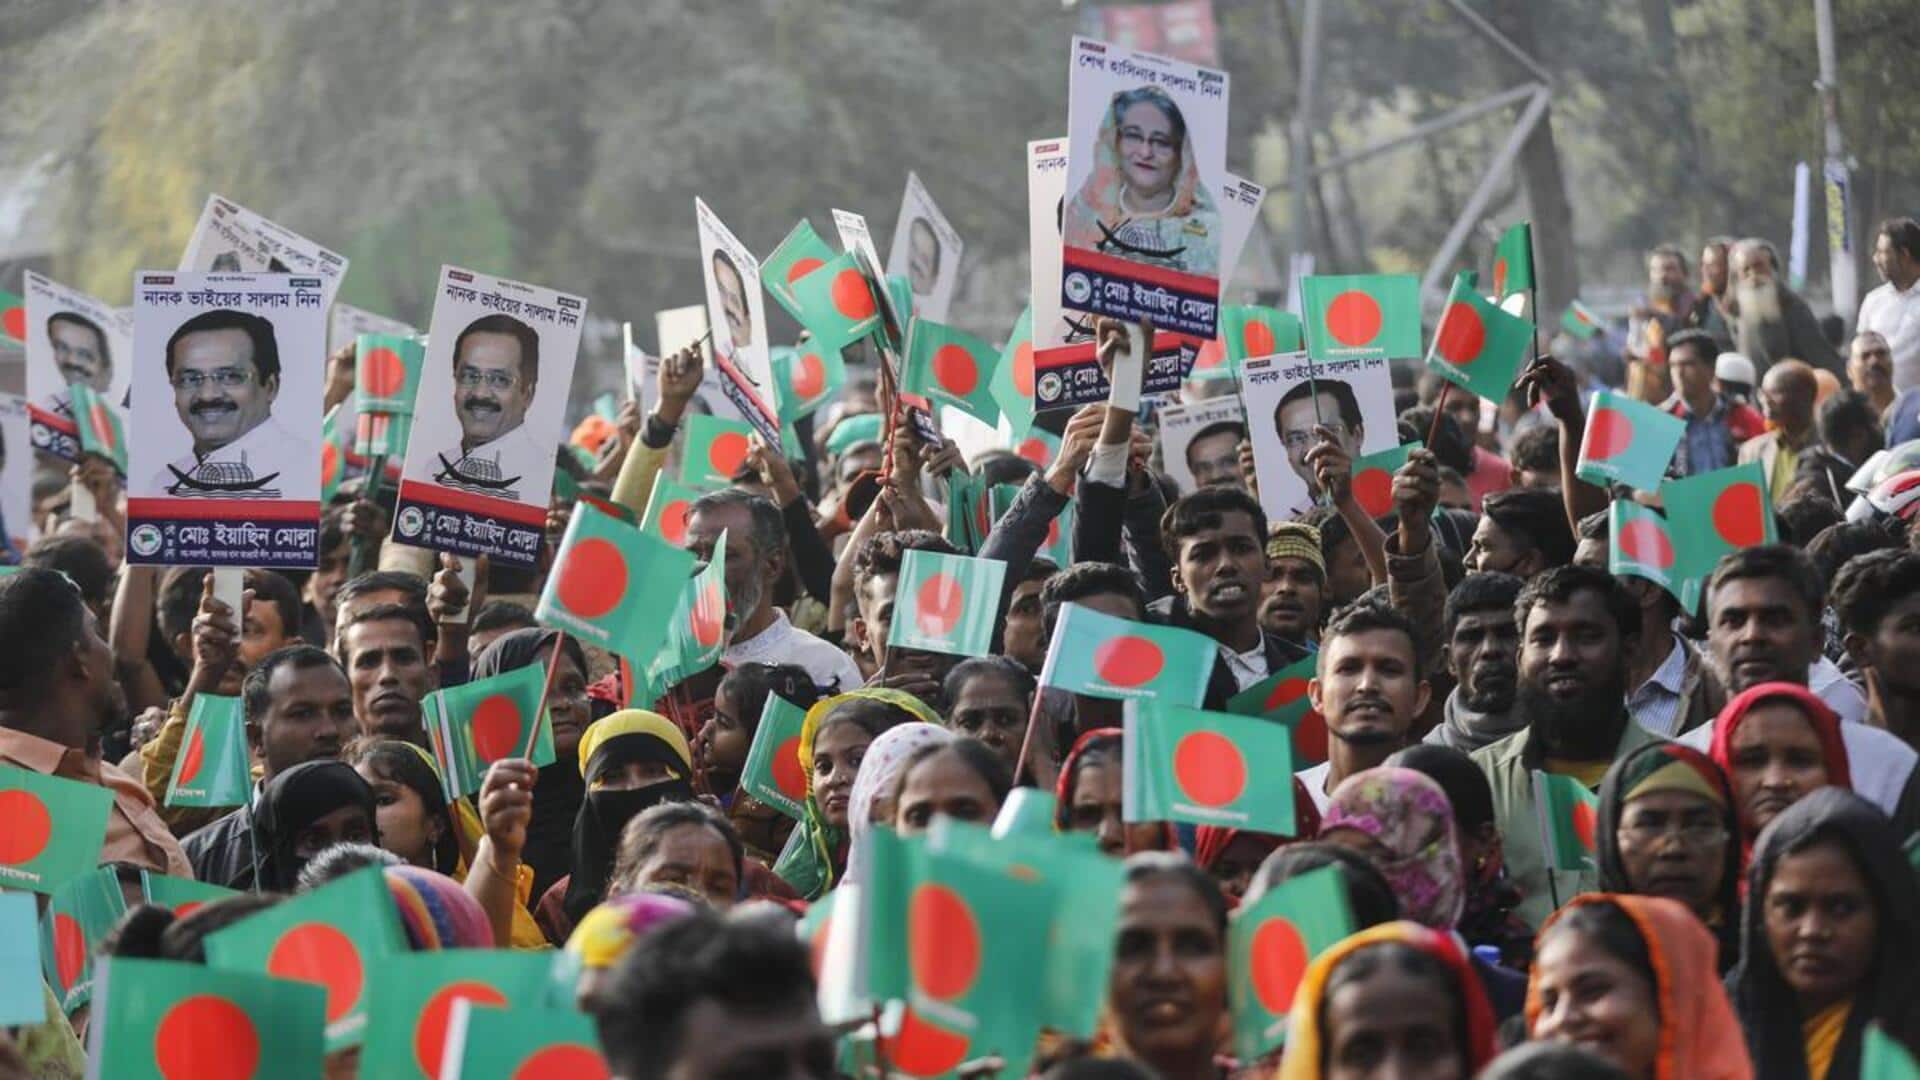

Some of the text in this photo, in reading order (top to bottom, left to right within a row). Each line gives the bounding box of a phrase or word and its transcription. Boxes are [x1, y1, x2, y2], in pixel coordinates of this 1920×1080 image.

[1079, 54, 1105, 70] শেখ
[1111, 59, 1156, 82] হাসিনার
[1162, 73, 1197, 92] সালাম
[1200, 78, 1222, 99] নিন
[143, 288, 321, 307] নানক ভাইয়ের সালাম নিন
[446, 284, 478, 302] নানক
[479, 291, 522, 314] ভাইয়ের
[524, 303, 556, 323] সালাম
[559, 307, 579, 328] নিন
[1104, 281, 1130, 302] মোঃ
[1133, 282, 1178, 314] ইয়াছিন
[1181, 298, 1216, 321] মোল্লা
[1248, 370, 1279, 384] নানক
[179, 525, 210, 545] মোঃ
[214, 521, 270, 547] ইয়াছিন
[275, 527, 317, 548] মোল্লা
[436, 515, 462, 534] মোঃ
[464, 514, 506, 545] ইয়াছিন
[508, 528, 540, 551] মোল্লা
